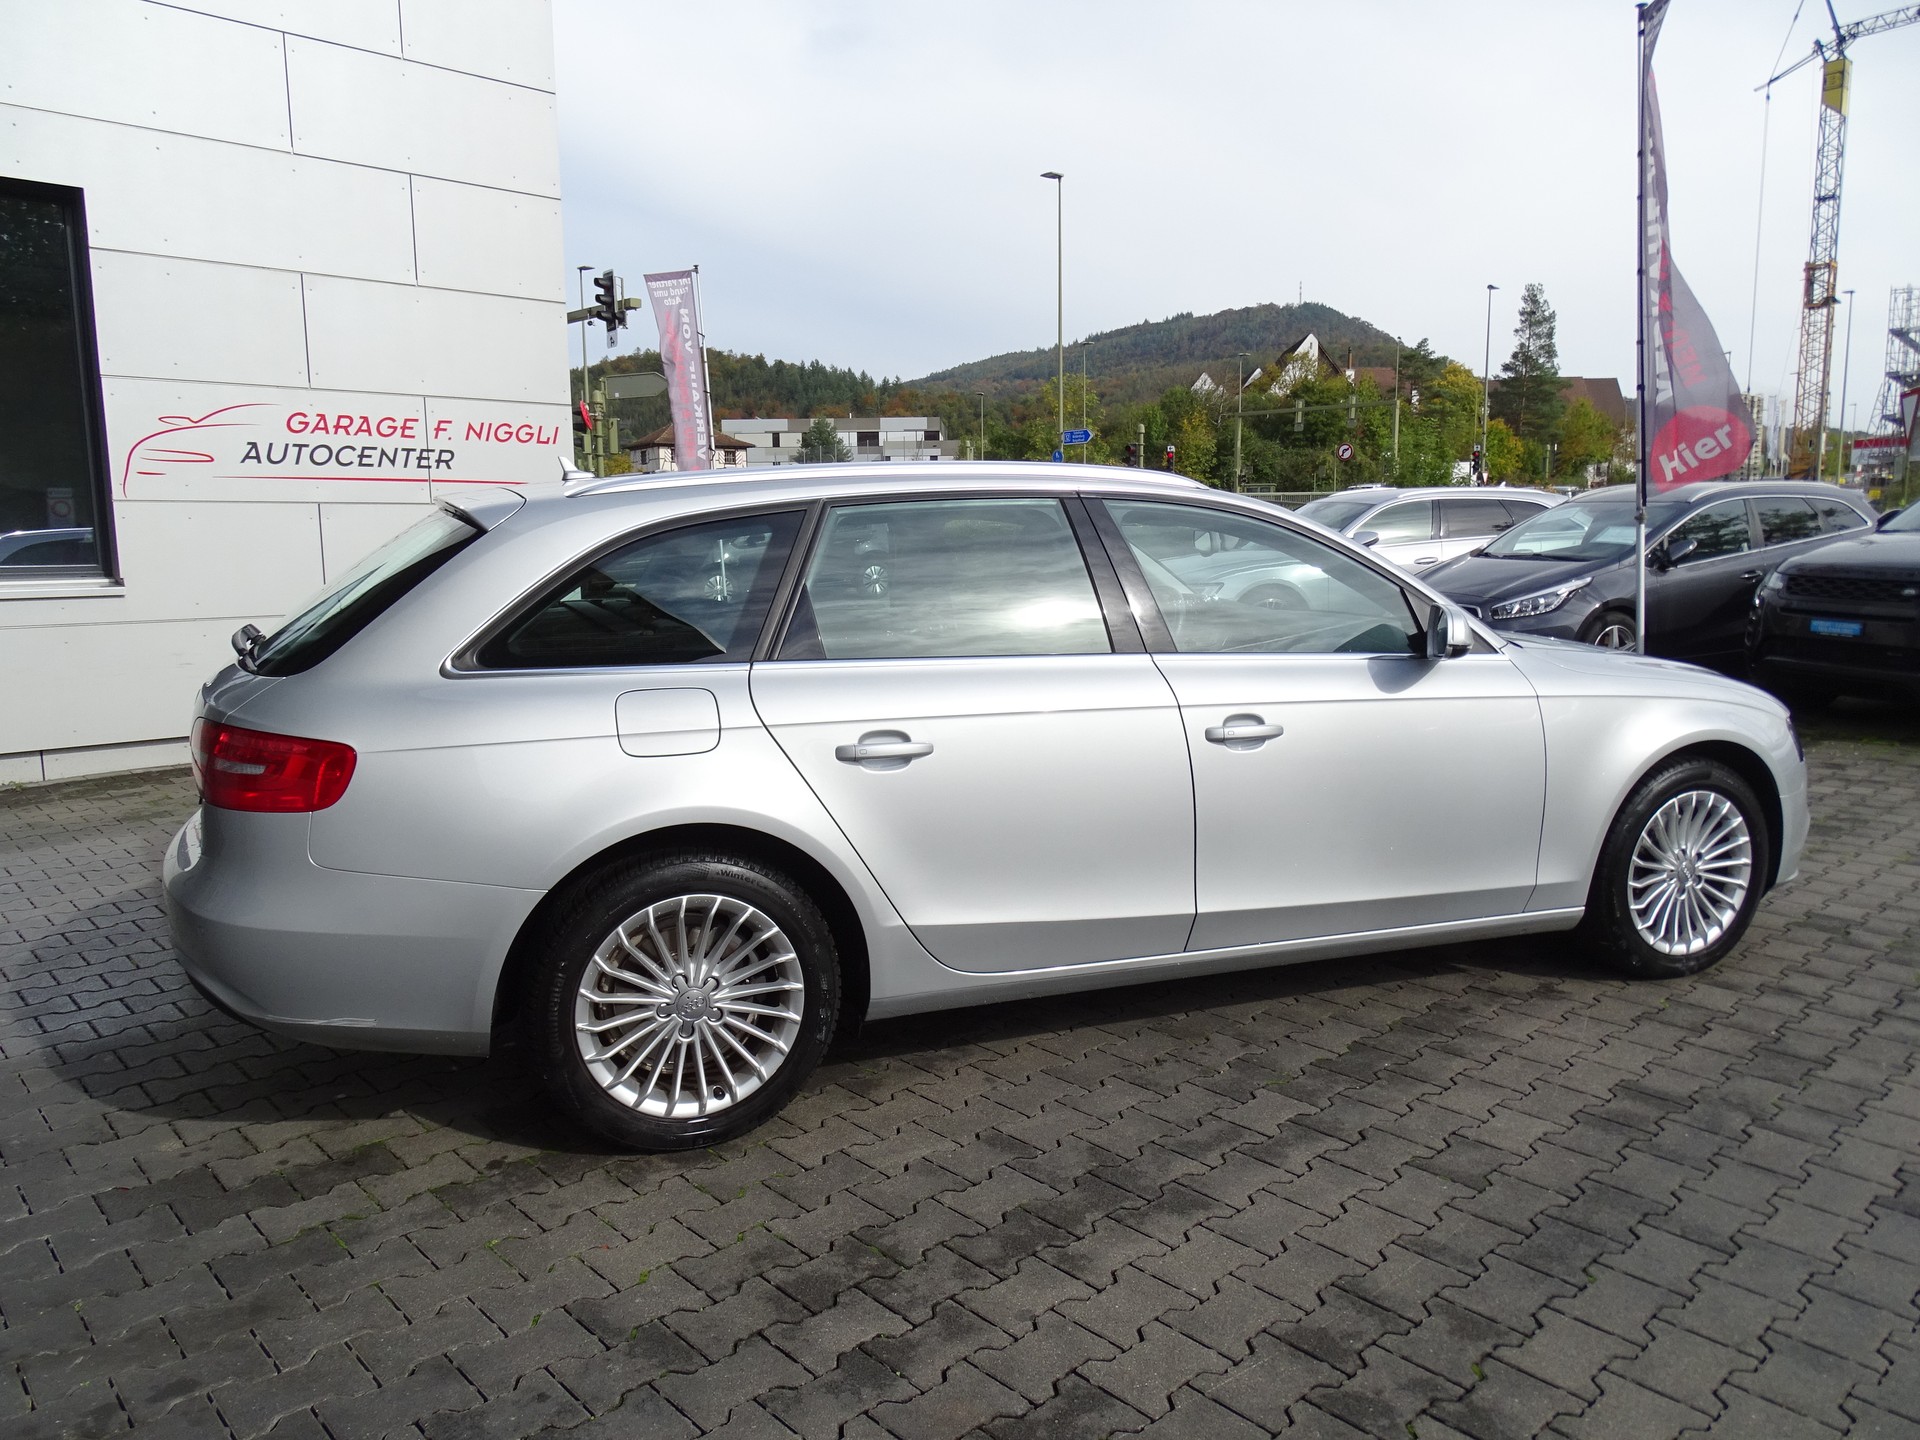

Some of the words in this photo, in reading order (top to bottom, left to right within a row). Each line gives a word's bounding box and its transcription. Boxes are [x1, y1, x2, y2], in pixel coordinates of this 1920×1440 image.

[286, 412, 419, 440] GARAGE
[433, 420, 453, 441] F.
[465, 422, 560, 445] NIGGLI
[240, 441, 456, 470] AUTOCENTER
[1658, 424, 1733, 482] Hier
